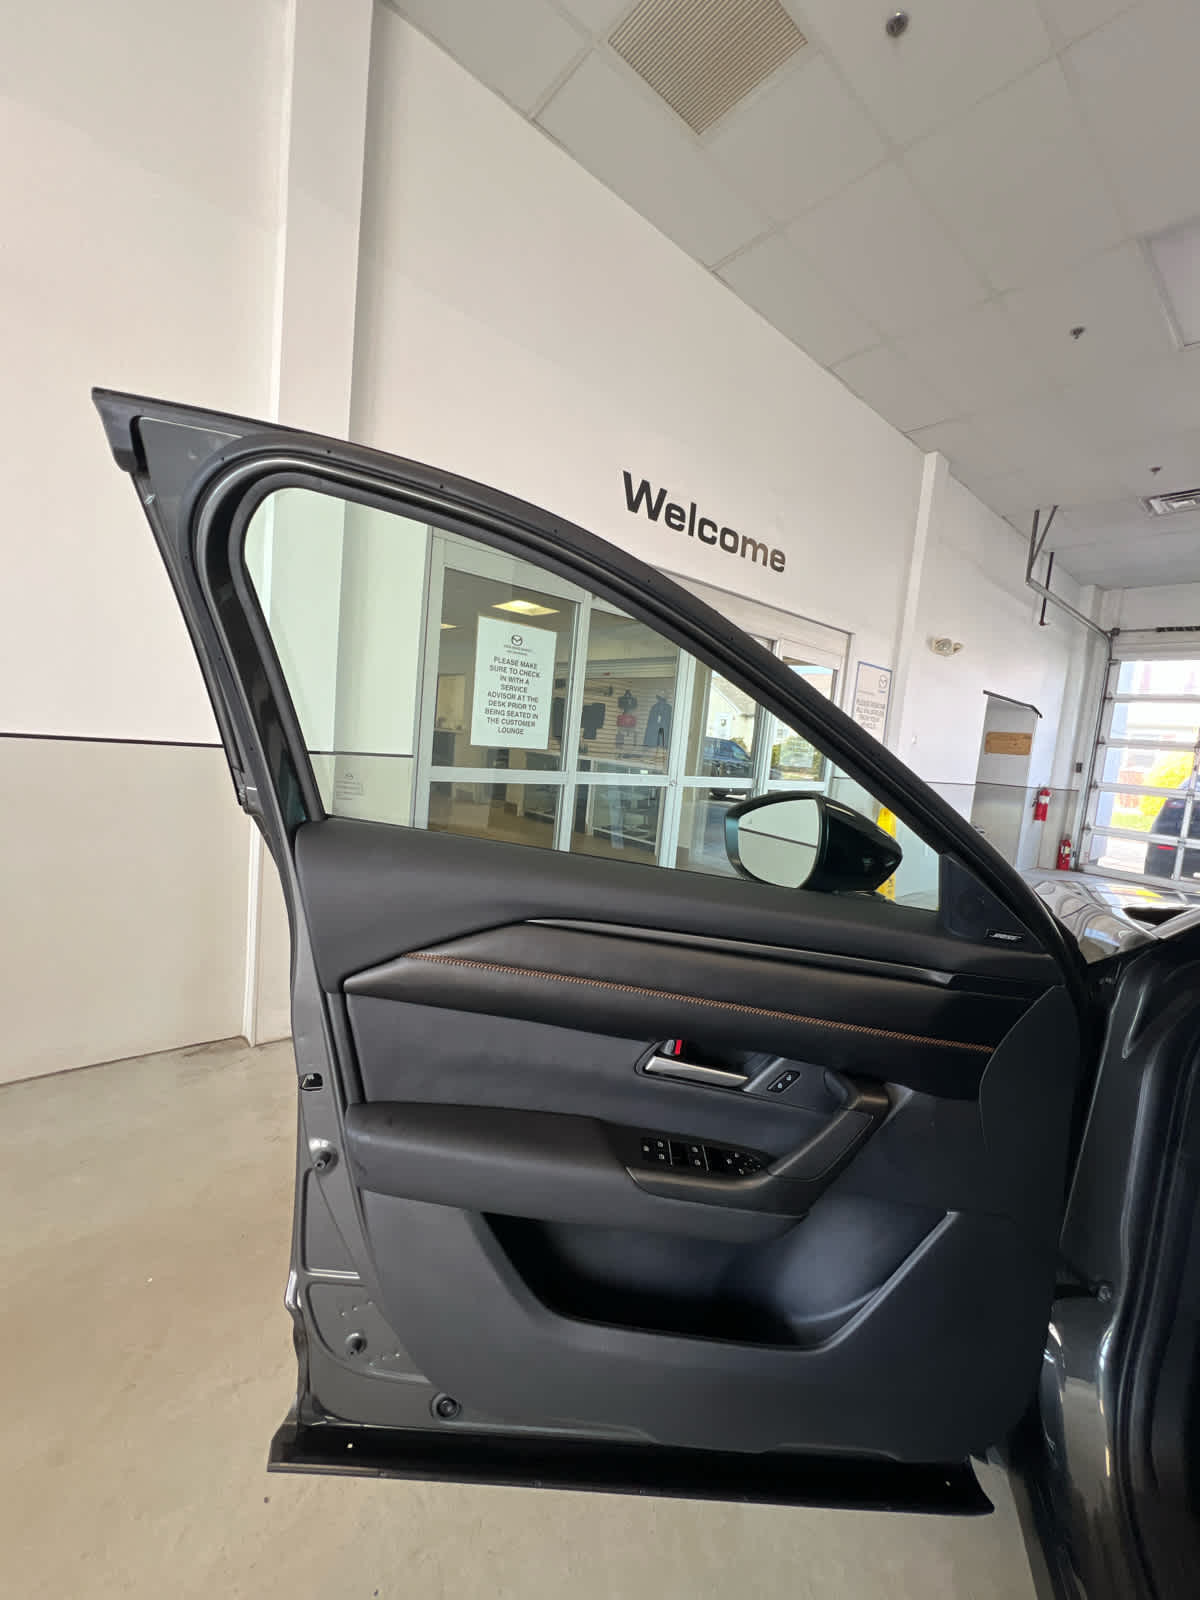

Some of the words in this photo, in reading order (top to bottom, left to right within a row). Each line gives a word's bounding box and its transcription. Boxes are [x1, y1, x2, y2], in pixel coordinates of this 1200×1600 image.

[623, 470, 786, 573] Welcome
[494, 656, 519, 667] PLEASE
[520, 660, 537, 670] MAKE
[489, 665, 508, 674] SURE
[509, 667, 518, 675] TO
[520, 668, 540, 678] CHECK
[500, 674, 507, 682] IN
[509, 675, 524, 684] WITH
[501, 684, 528, 693] SERVICE
[487, 691, 516, 700] ADVISOR
[527, 696, 539, 704] THE
[488, 700, 506, 708] DESK
[508, 702, 527, 710] PRIOR
[528, 704, 537, 712] TO
[485, 708, 505, 717] BEING
[506, 710, 531, 720] SEATED
[532, 712, 539, 720] IN
[487, 717, 499, 725] THE
[501, 718, 536, 728] CUSTOMER
[497, 727, 524, 735] LOUNGE
